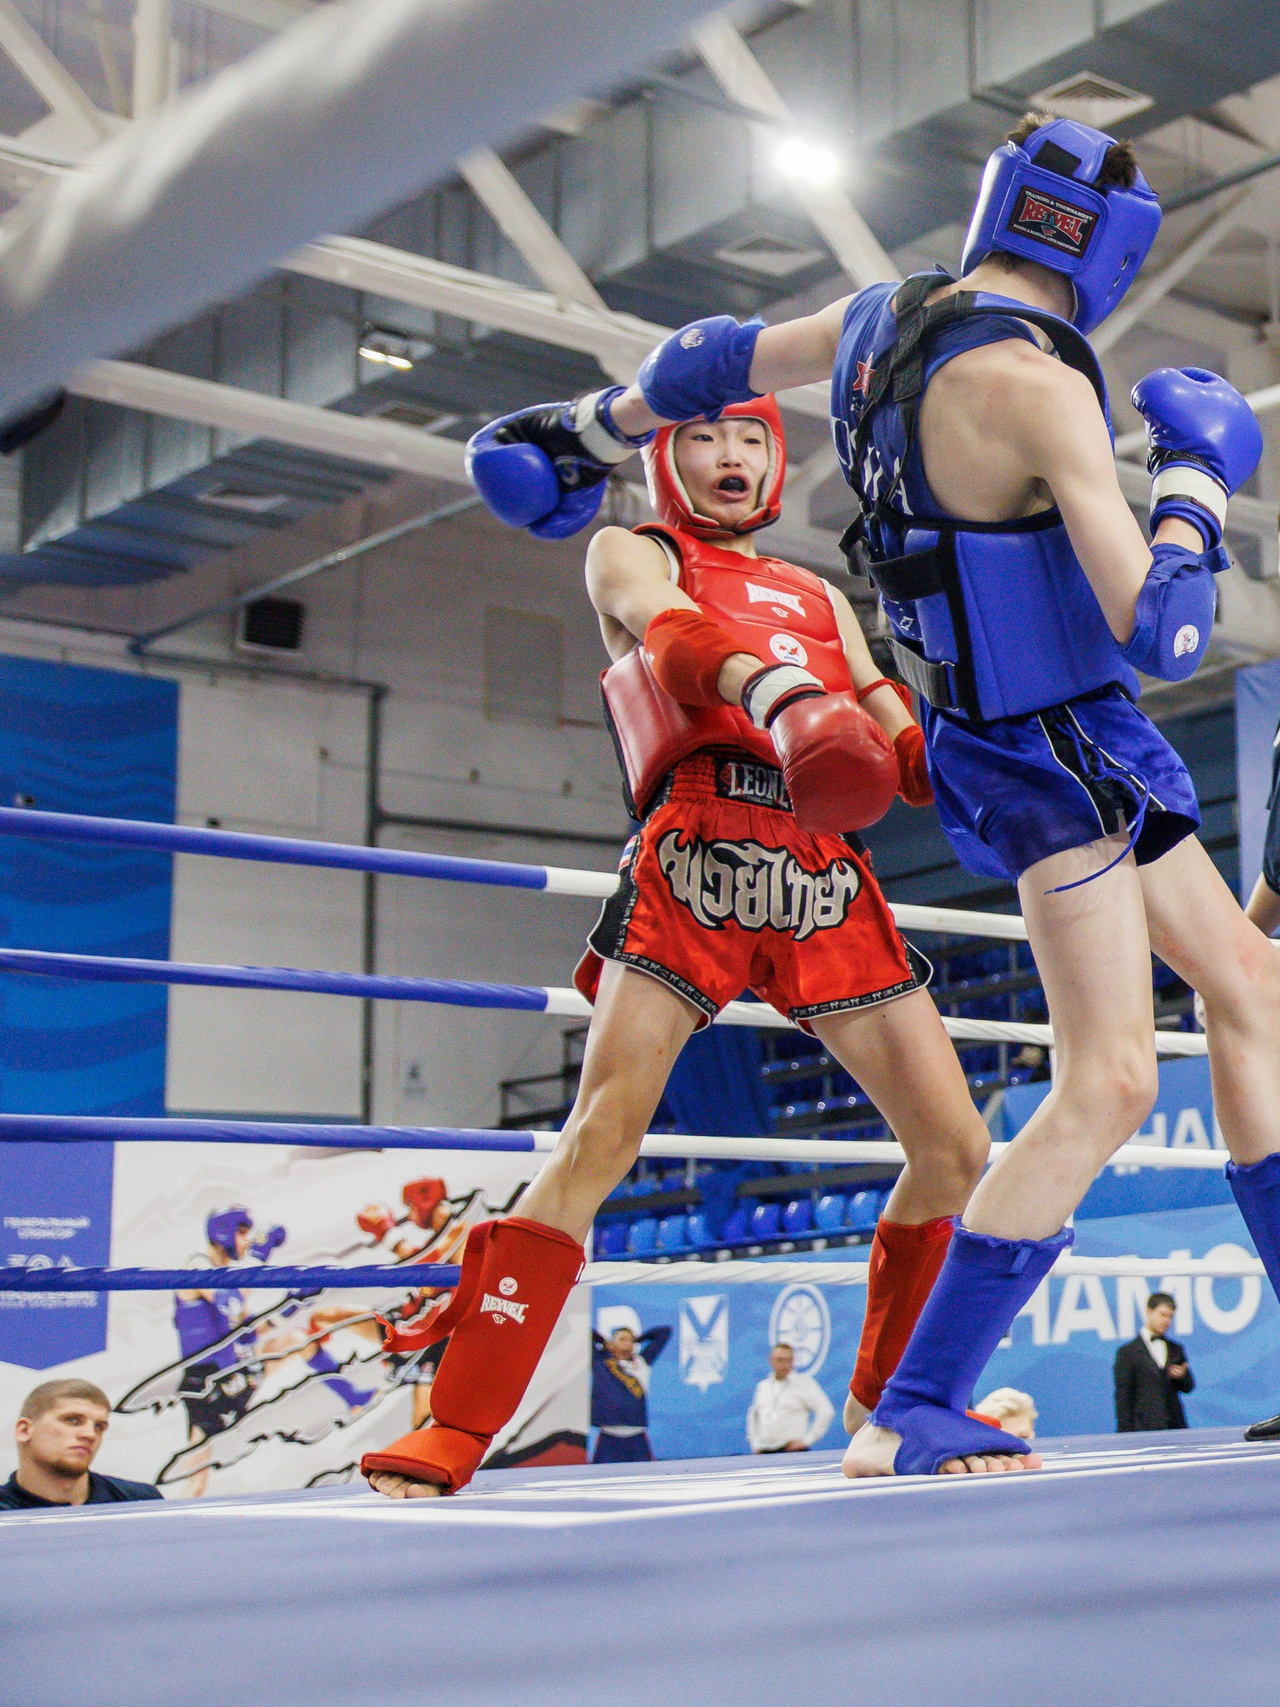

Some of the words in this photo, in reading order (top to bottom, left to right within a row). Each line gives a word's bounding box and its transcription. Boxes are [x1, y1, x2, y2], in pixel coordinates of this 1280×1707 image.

[1018, 196, 1084, 246] REYVEL
[1025, 190, 1050, 203] TRAINING
[1055, 202, 1094, 221] TOURNAMENT
[480, 1292, 529, 1324] REYVEL
